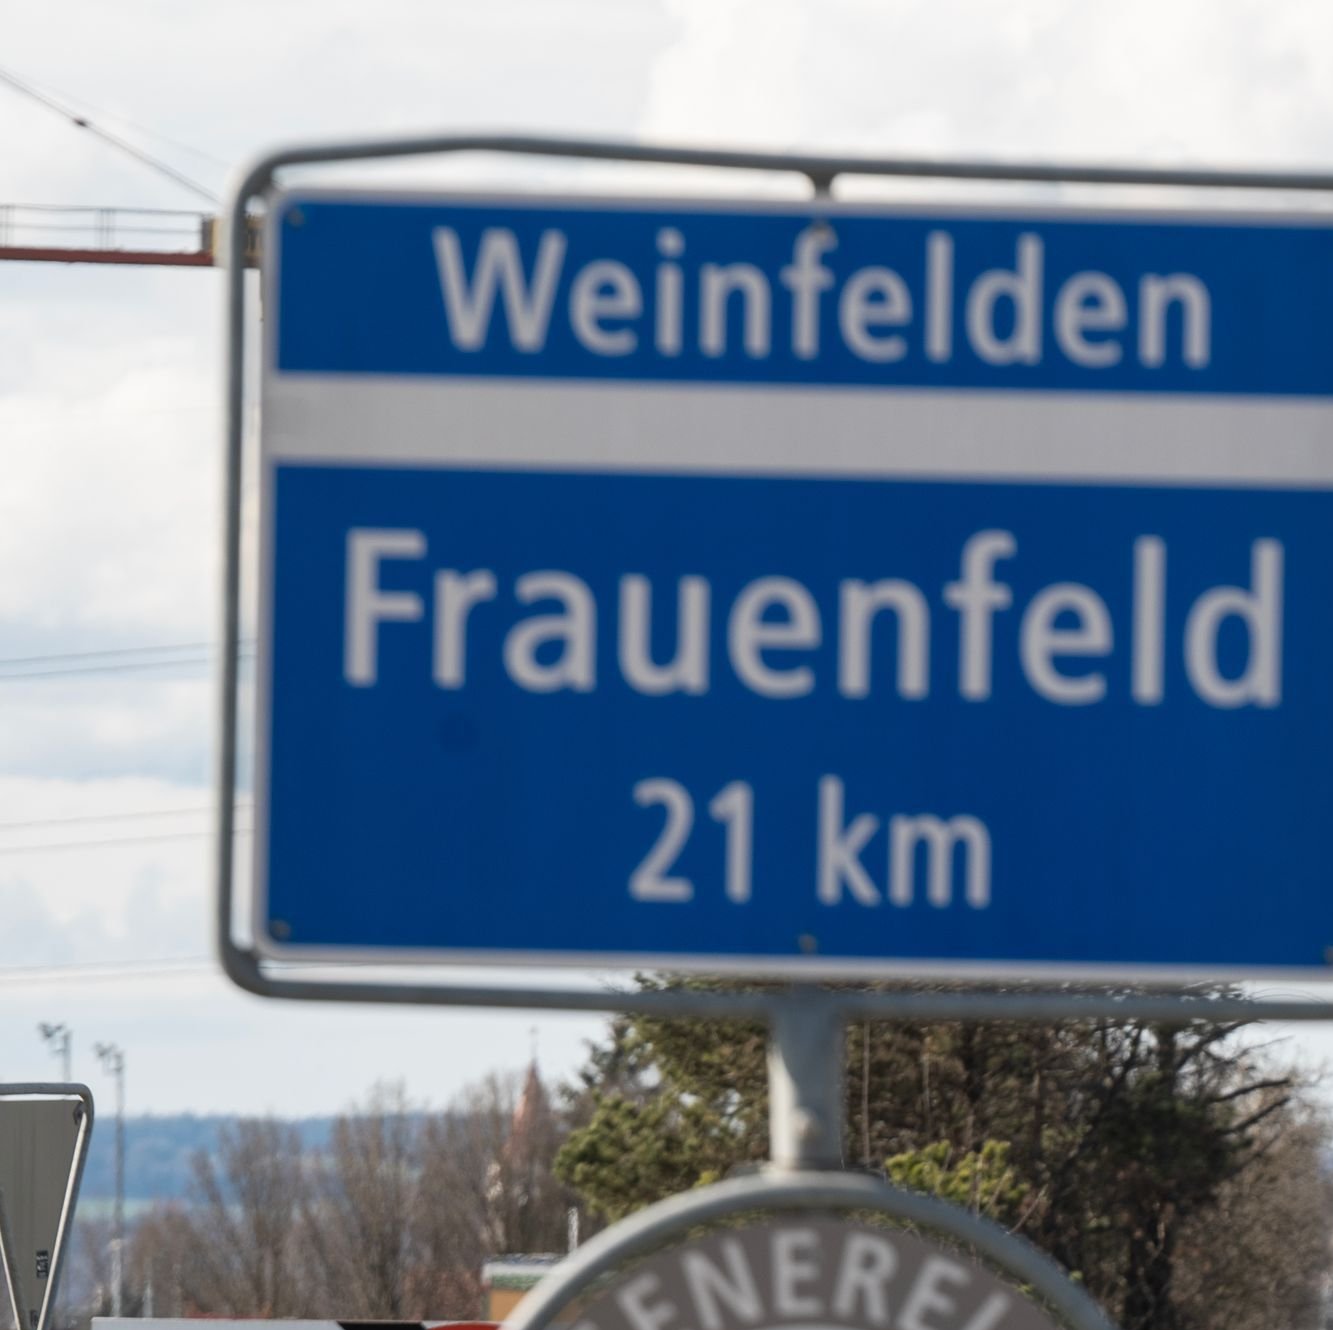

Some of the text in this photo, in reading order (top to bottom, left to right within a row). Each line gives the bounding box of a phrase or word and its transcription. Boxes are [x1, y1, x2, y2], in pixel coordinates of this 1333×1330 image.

[433, 226, 1212, 368] Weinfelden
[344, 528, 1284, 708] Frauenfeld
[629, 776, 991, 907] 21 km
